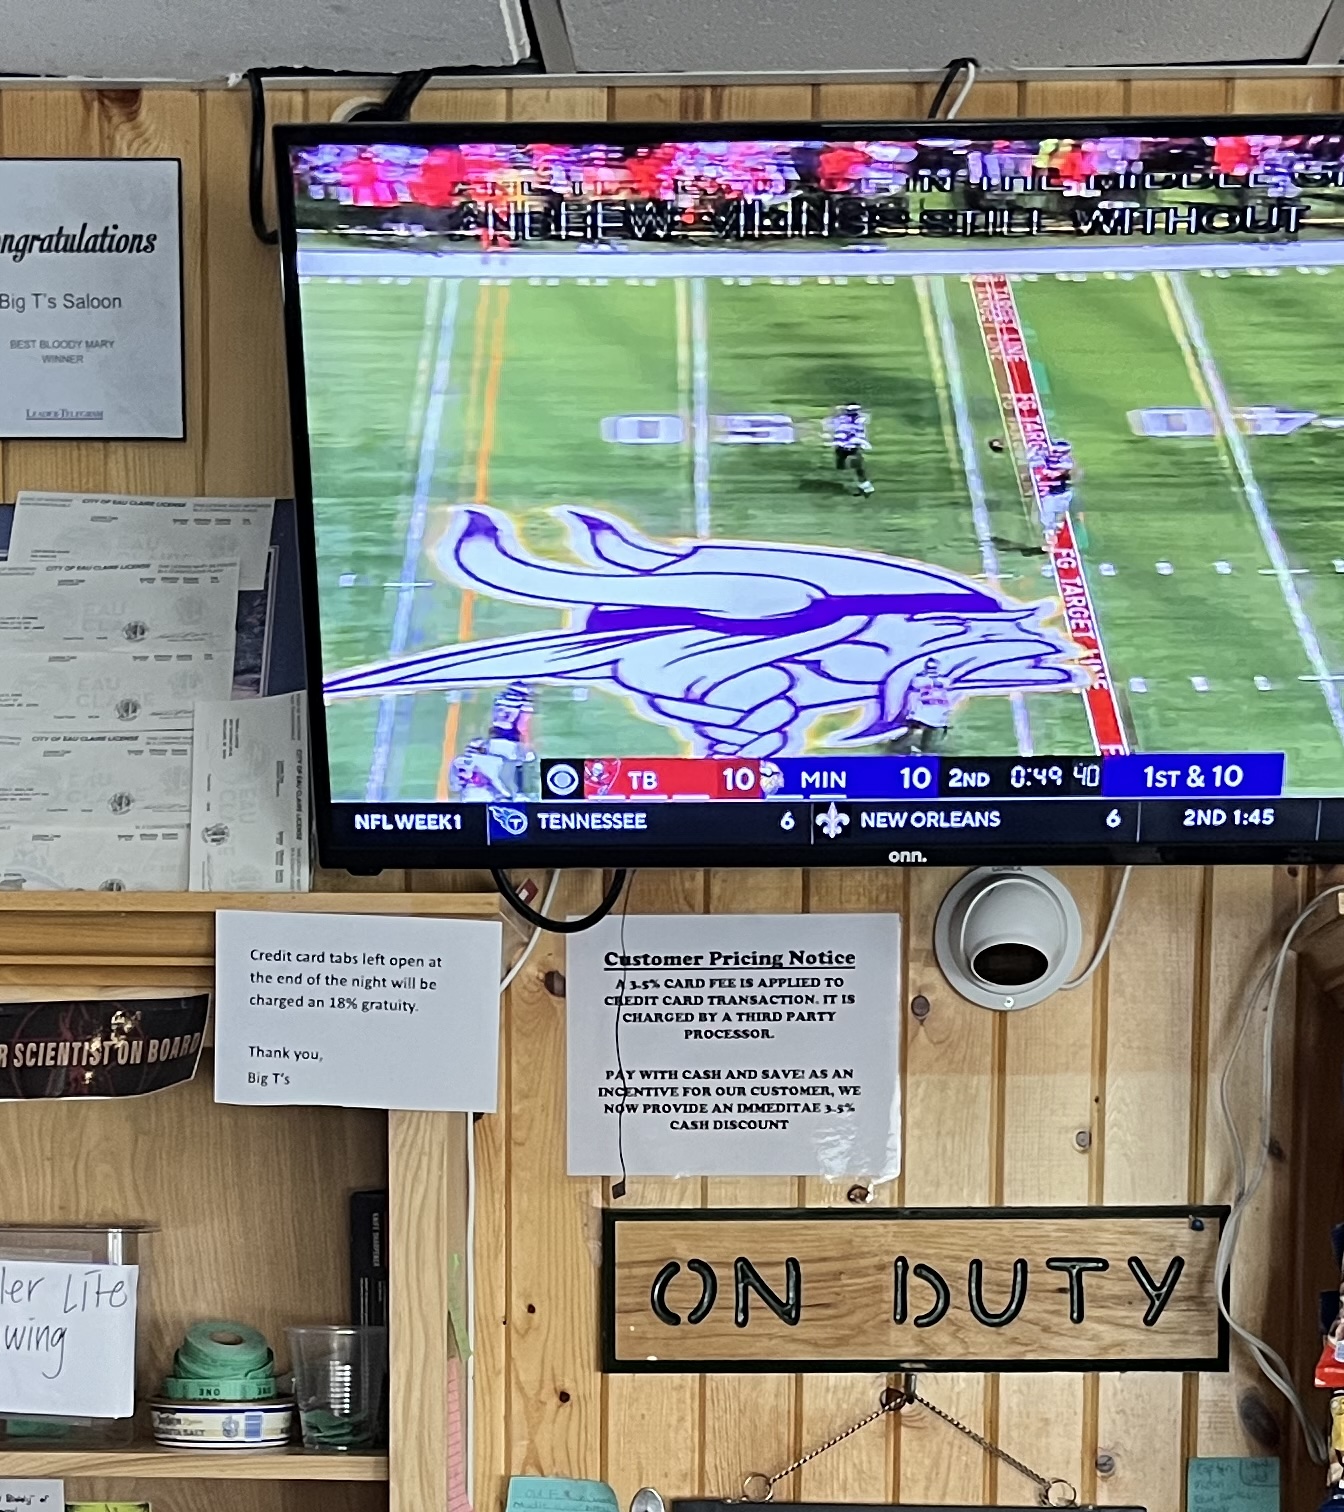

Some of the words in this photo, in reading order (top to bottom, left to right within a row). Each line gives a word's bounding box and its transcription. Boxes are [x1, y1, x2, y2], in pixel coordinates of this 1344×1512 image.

[32, 293, 57, 309] T's
[63, 293, 122, 309] Saloon
[10, 340, 36, 349] BEST
[39, 340, 82, 349] BLOODY
[85, 340, 114, 349] MARY
[42, 355, 84, 364] WINNER
[628, 771, 658, 790] TB
[722, 767, 755, 790] 10
[800, 770, 846, 789] MIN
[900, 766, 932, 790] 10
[948, 768, 990, 788] 2ND
[1010, 766, 1062, 788] 0:49
[1072, 764, 1100, 787] 40
[1143, 766, 1180, 790] 1ST
[1186, 766, 1206, 789] &
[1212, 765, 1243, 788] 10
[354, 814, 394, 830] NFL
[538, 812, 648, 830] TENNESSEE
[780, 812, 795, 830] 6
[860, 812, 909, 828] NEW
[913, 811, 1001, 828] ORLEANS
[1106, 810, 1121, 828] 6
[1183, 809, 1226, 826] 2ND
[1233, 809, 1275, 826] 1:45
[250, 949, 292, 962] Credit
[296, 952, 325, 963] card
[330, 953, 358, 965] tabs
[362, 953, 386, 965] left
[390, 956, 424, 969] open
[429, 957, 442, 968] at
[604, 951, 704, 966] Customer
[709, 951, 783, 967] Pricing
[789, 950, 855, 965] Notice
[250, 972, 272, 984] the
[277, 974, 302, 985] end
[307, 974, 321, 986] of
[325, 974, 347, 986] the
[352, 976, 387, 990] night
[391, 977, 416, 989] will
[420, 977, 437, 990] be
[616, 979, 624, 989] A
[629, 979, 660, 990] 3.5%
[664, 979, 705, 988] CARD
[709, 978, 736, 988] FEE
[740, 978, 753, 988] IS
[757, 978, 821, 988] APPLIED
[825, 978, 844, 988] TO
[249, 995, 303, 1009] charged
[308, 998, 324, 1008] an
[330, 997, 357, 1009] 18%
[361, 1000, 419, 1014] gratuity.
[604, 996, 659, 1006] CREDIT
[662, 996, 704, 1006] CARD
[707, 995, 819, 1005] TRANSACTION.
[823, 995, 837, 1004] IT
[842, 995, 855, 1004] IS
[622, 1012, 694, 1022] CHARGED
[699, 1012, 718, 1022] BY
[722, 1012, 732, 1022] A
[736, 1012, 782, 1022] THIRD
[786, 1012, 836, 1022] PARTY
[684, 1029, 775, 1039] PROCESSOR.
[13, 1041, 109, 1068] SCIENTIST
[117, 1040, 143, 1065] ON
[147, 1032, 201, 1063] BOARD
[248, 1046, 290, 1059] Thank
[294, 1049, 323, 1063] you,
[248, 1072, 268, 1086] Big
[272, 1073, 290, 1085] T's
[606, 1070, 636, 1080] PAY
[639, 1070, 678, 1080] WITH
[682, 1070, 721, 1079] CASH
[725, 1070, 757, 1079] AND
[761, 1069, 805, 1079] SAVE!
[808, 1070, 828, 1079] AS
[832, 1069, 853, 1079] AN
[598, 1087, 679, 1097] INCENTIVE
[683, 1087, 711, 1097] FOR
[715, 1086, 747, 1096] OUR
[750, 1086, 835, 1097] CUSTOMER,
[838, 1086, 861, 1096] WE
[604, 1104, 638, 1114] NOW
[642, 1104, 709, 1113] PROVIDE
[712, 1103, 733, 1113] AN
[737, 1103, 821, 1113] IMMEDITAE
[824, 1103, 856, 1113] 3.5%
[670, 1120, 709, 1130] CASH
[713, 1120, 789, 1130] DISCOUNT
[651, 1255, 801, 1327] ON
[893, 1255, 1186, 1328] DUTY
